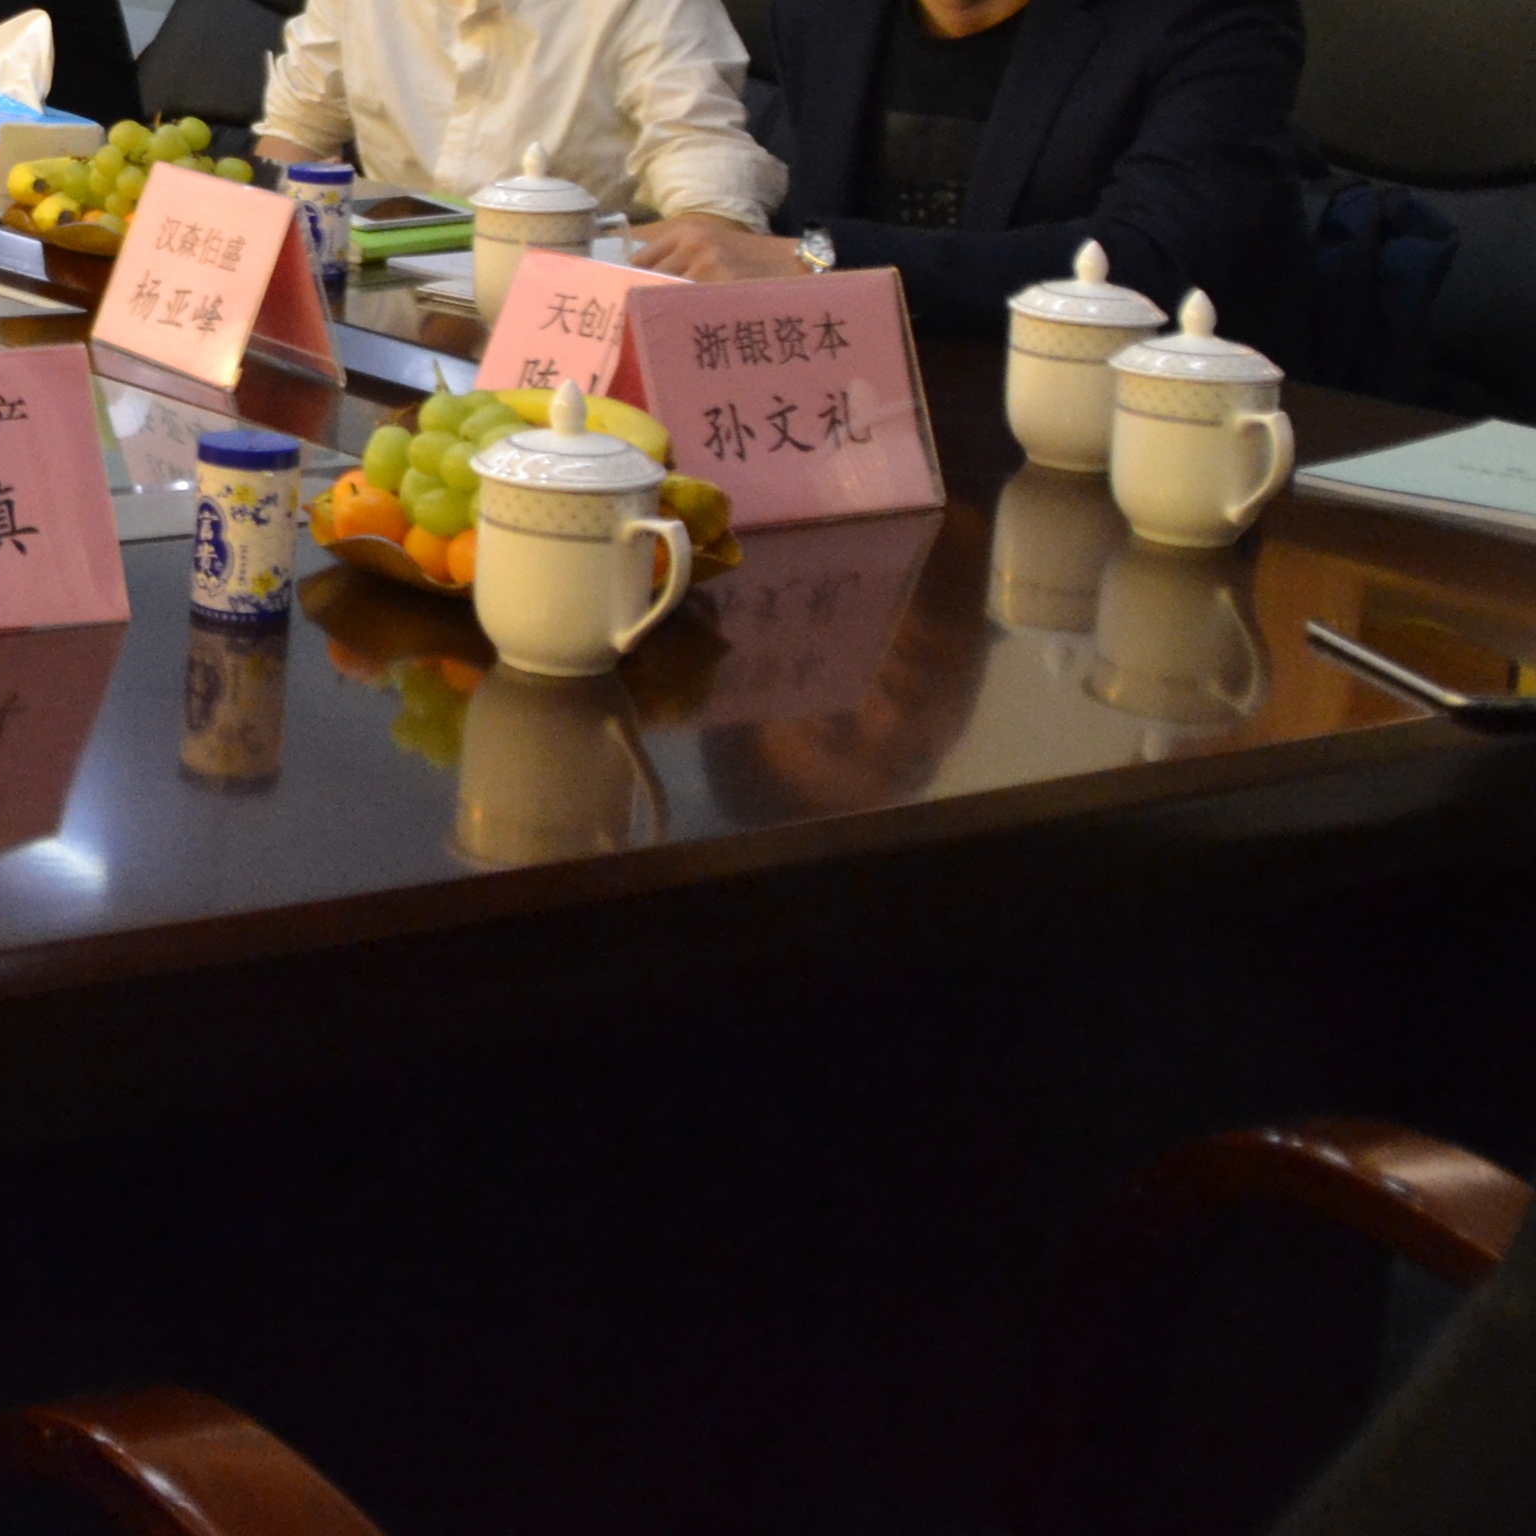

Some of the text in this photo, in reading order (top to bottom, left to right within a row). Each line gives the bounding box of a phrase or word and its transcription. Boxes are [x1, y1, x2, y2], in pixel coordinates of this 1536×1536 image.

[156, 217, 247, 273] 汉森伯盛
[129, 269, 224, 342] 杨亚峰
[692, 311, 852, 371] 浙银资本
[703, 389, 872, 462] 孙文礼
